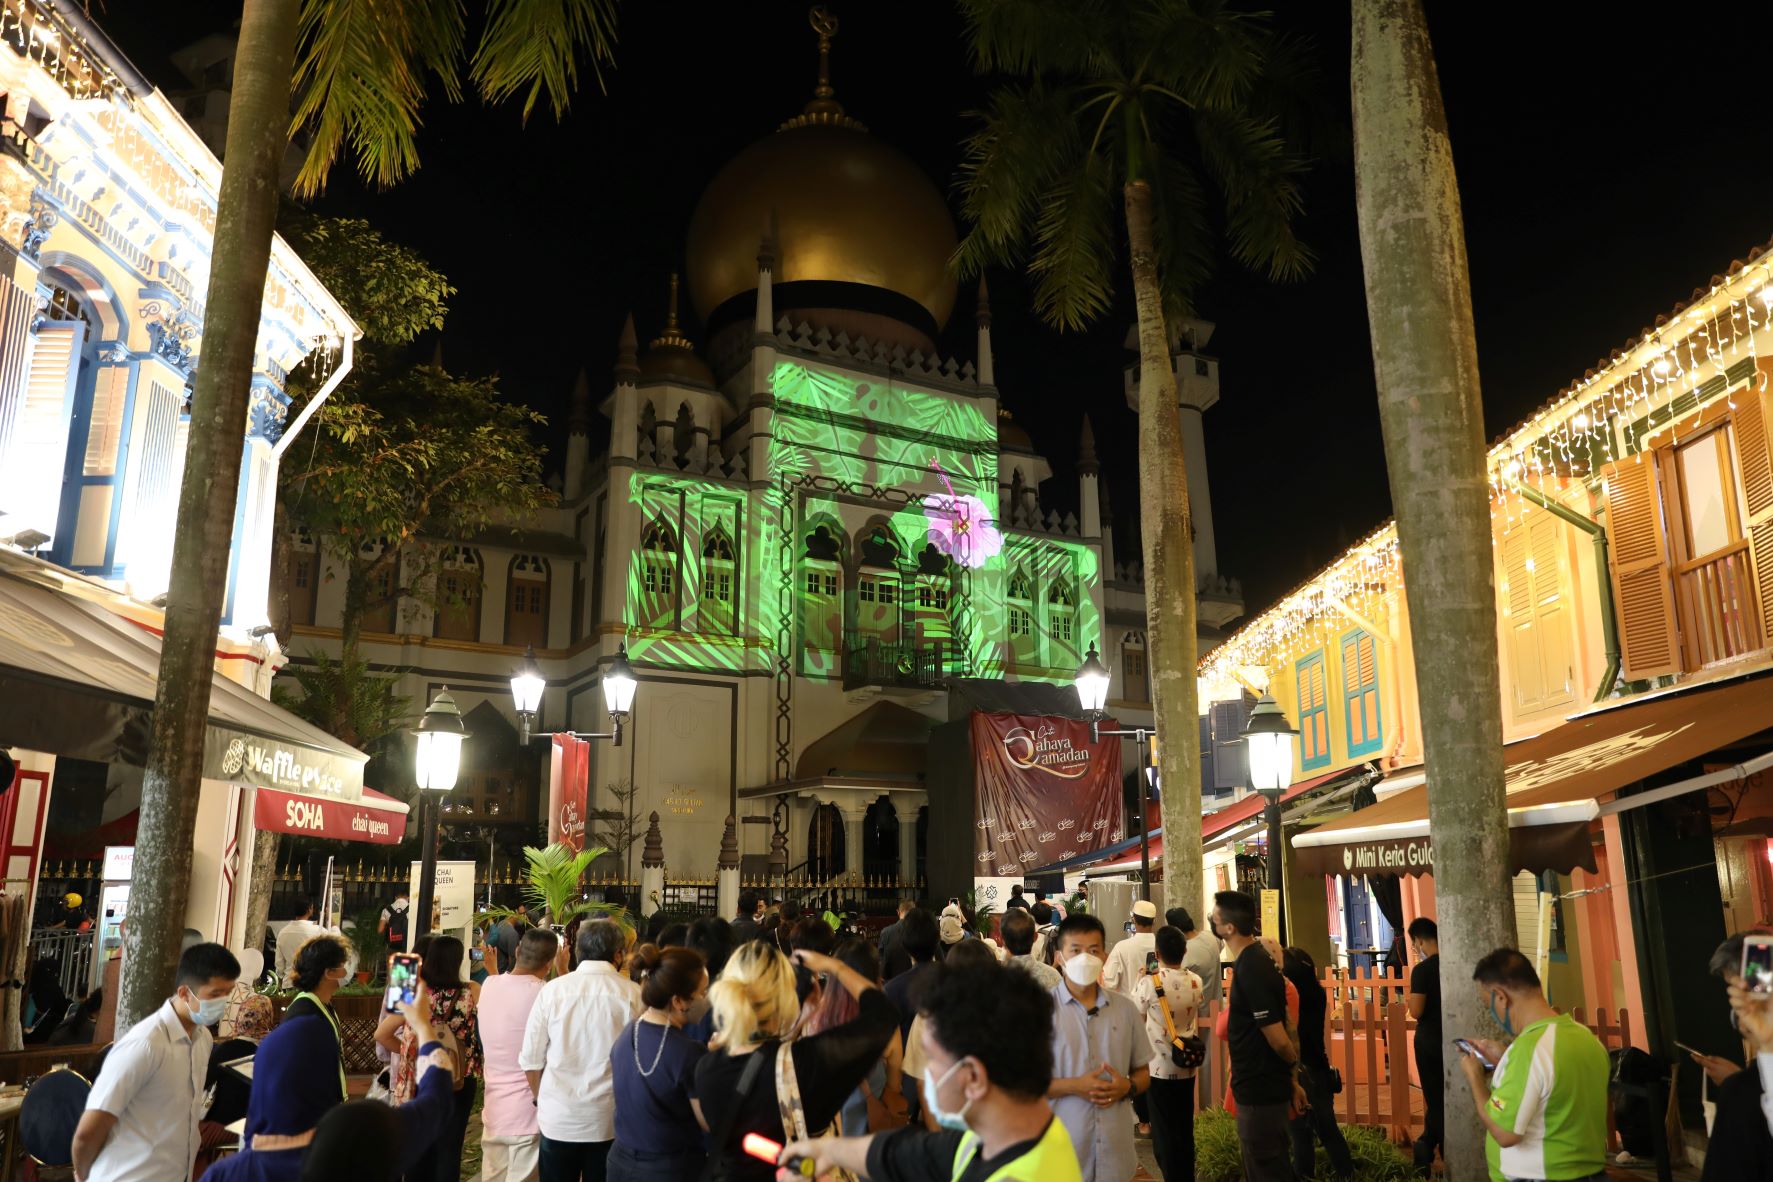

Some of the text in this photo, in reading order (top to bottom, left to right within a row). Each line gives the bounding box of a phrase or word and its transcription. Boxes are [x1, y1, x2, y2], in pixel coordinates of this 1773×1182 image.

[248, 745, 301, 784] Waffle
[285, 799, 324, 831] SOHA
[352, 812, 389, 838] chai queen
[1355, 845, 1377, 868] Mini
[1377, 844, 1406, 867] Keria
[434, 876, 454, 886] QUEEN
[436, 868, 452, 876] CHAI
